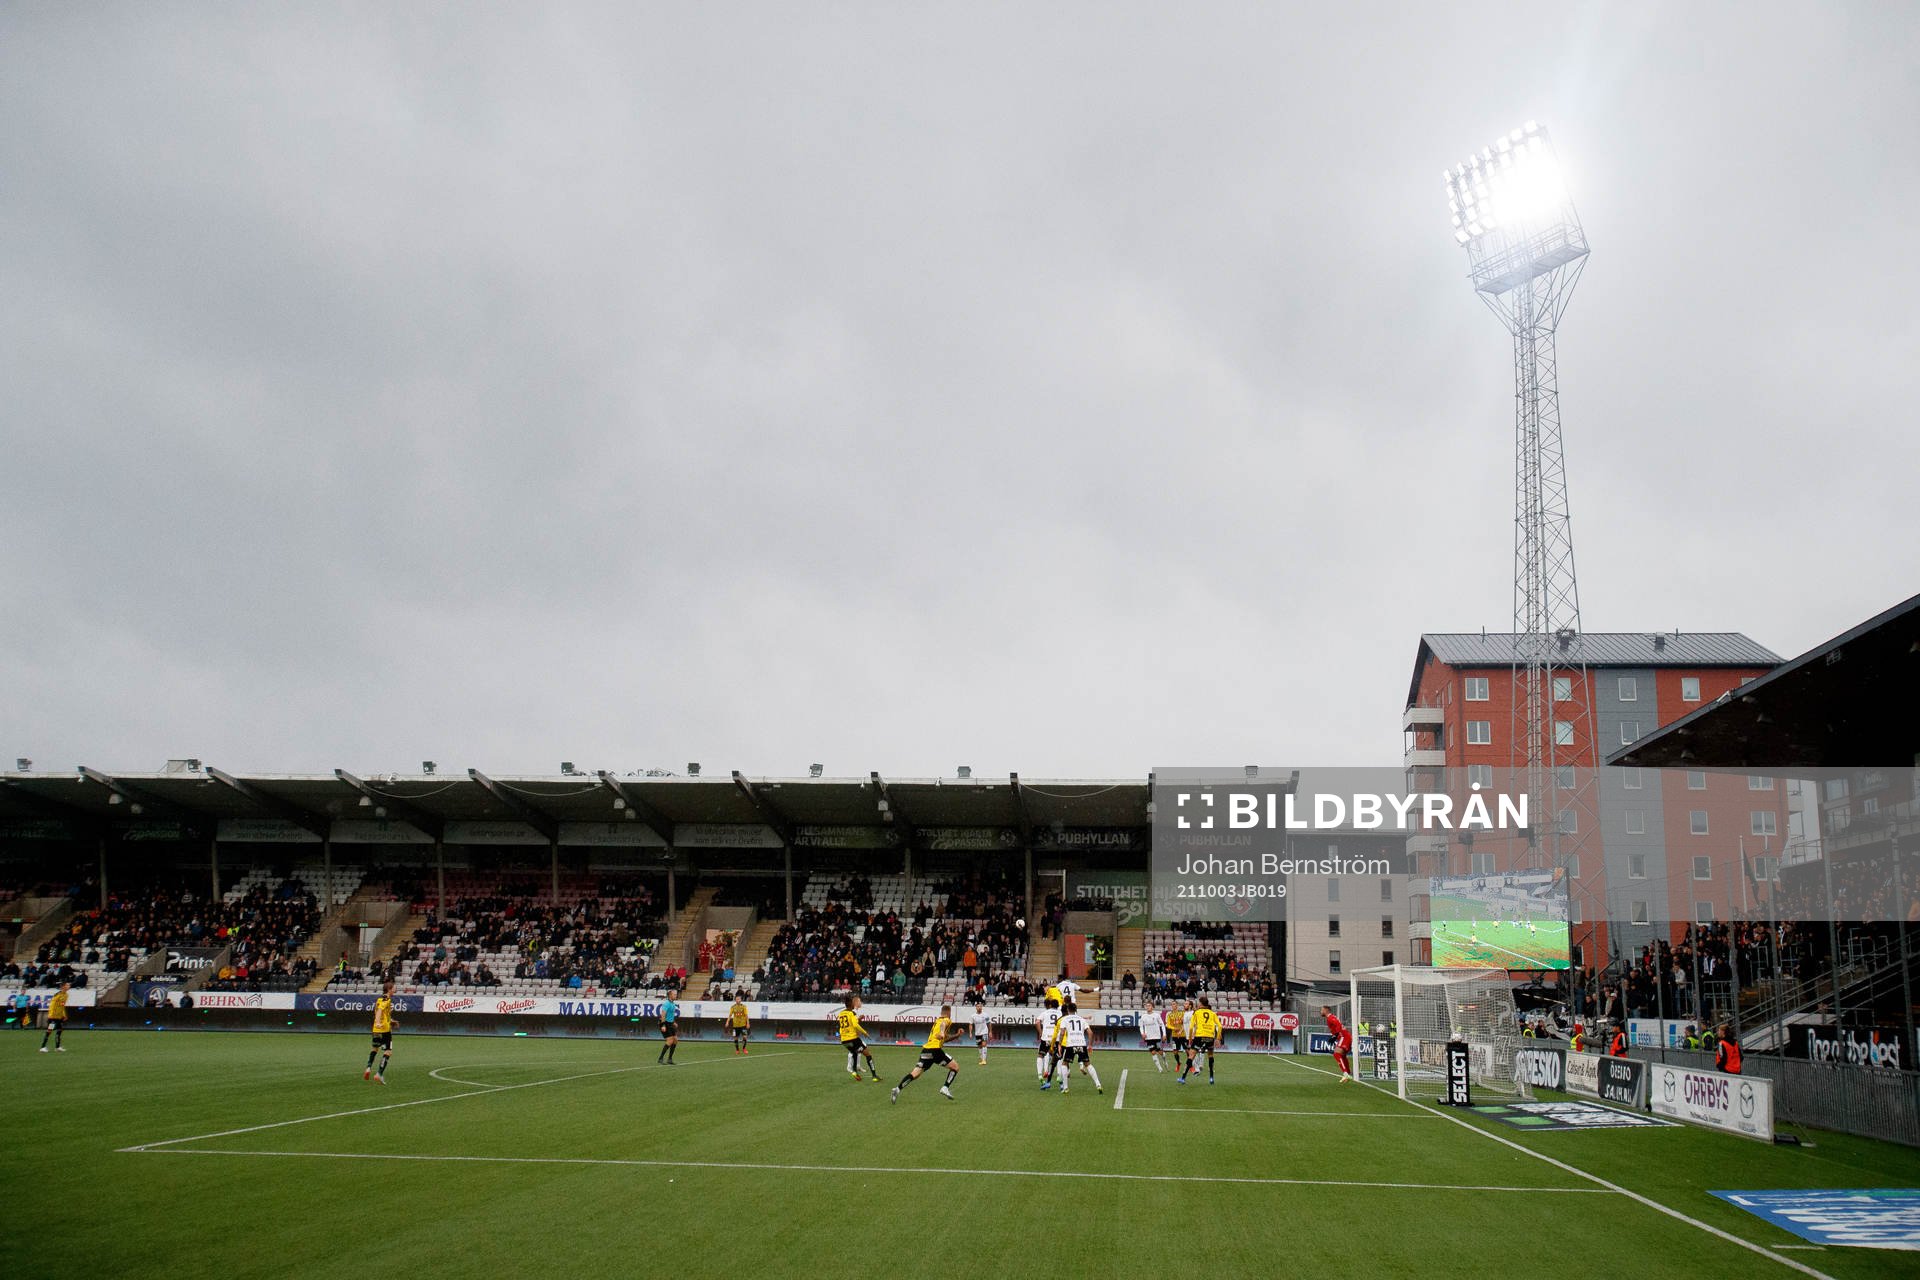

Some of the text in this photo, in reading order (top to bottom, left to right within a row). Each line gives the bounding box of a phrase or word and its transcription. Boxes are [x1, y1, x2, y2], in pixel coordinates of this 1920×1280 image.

[1057, 832, 1130, 845] PUBHYLLAN
[1063, 985, 1071, 996] 4
[200, 995, 247, 1007] BEHRN
[334, 998, 363, 1011] Care
[839, 1015, 850, 1029] 33
[1050, 1013, 1058, 1025] 9
[1203, 1012, 1210, 1024] 9
[1069, 1019, 1082, 1031] 11
[1376, 1038, 1390, 1080] SELECT
[1452, 1050, 1468, 1103] SELECT
